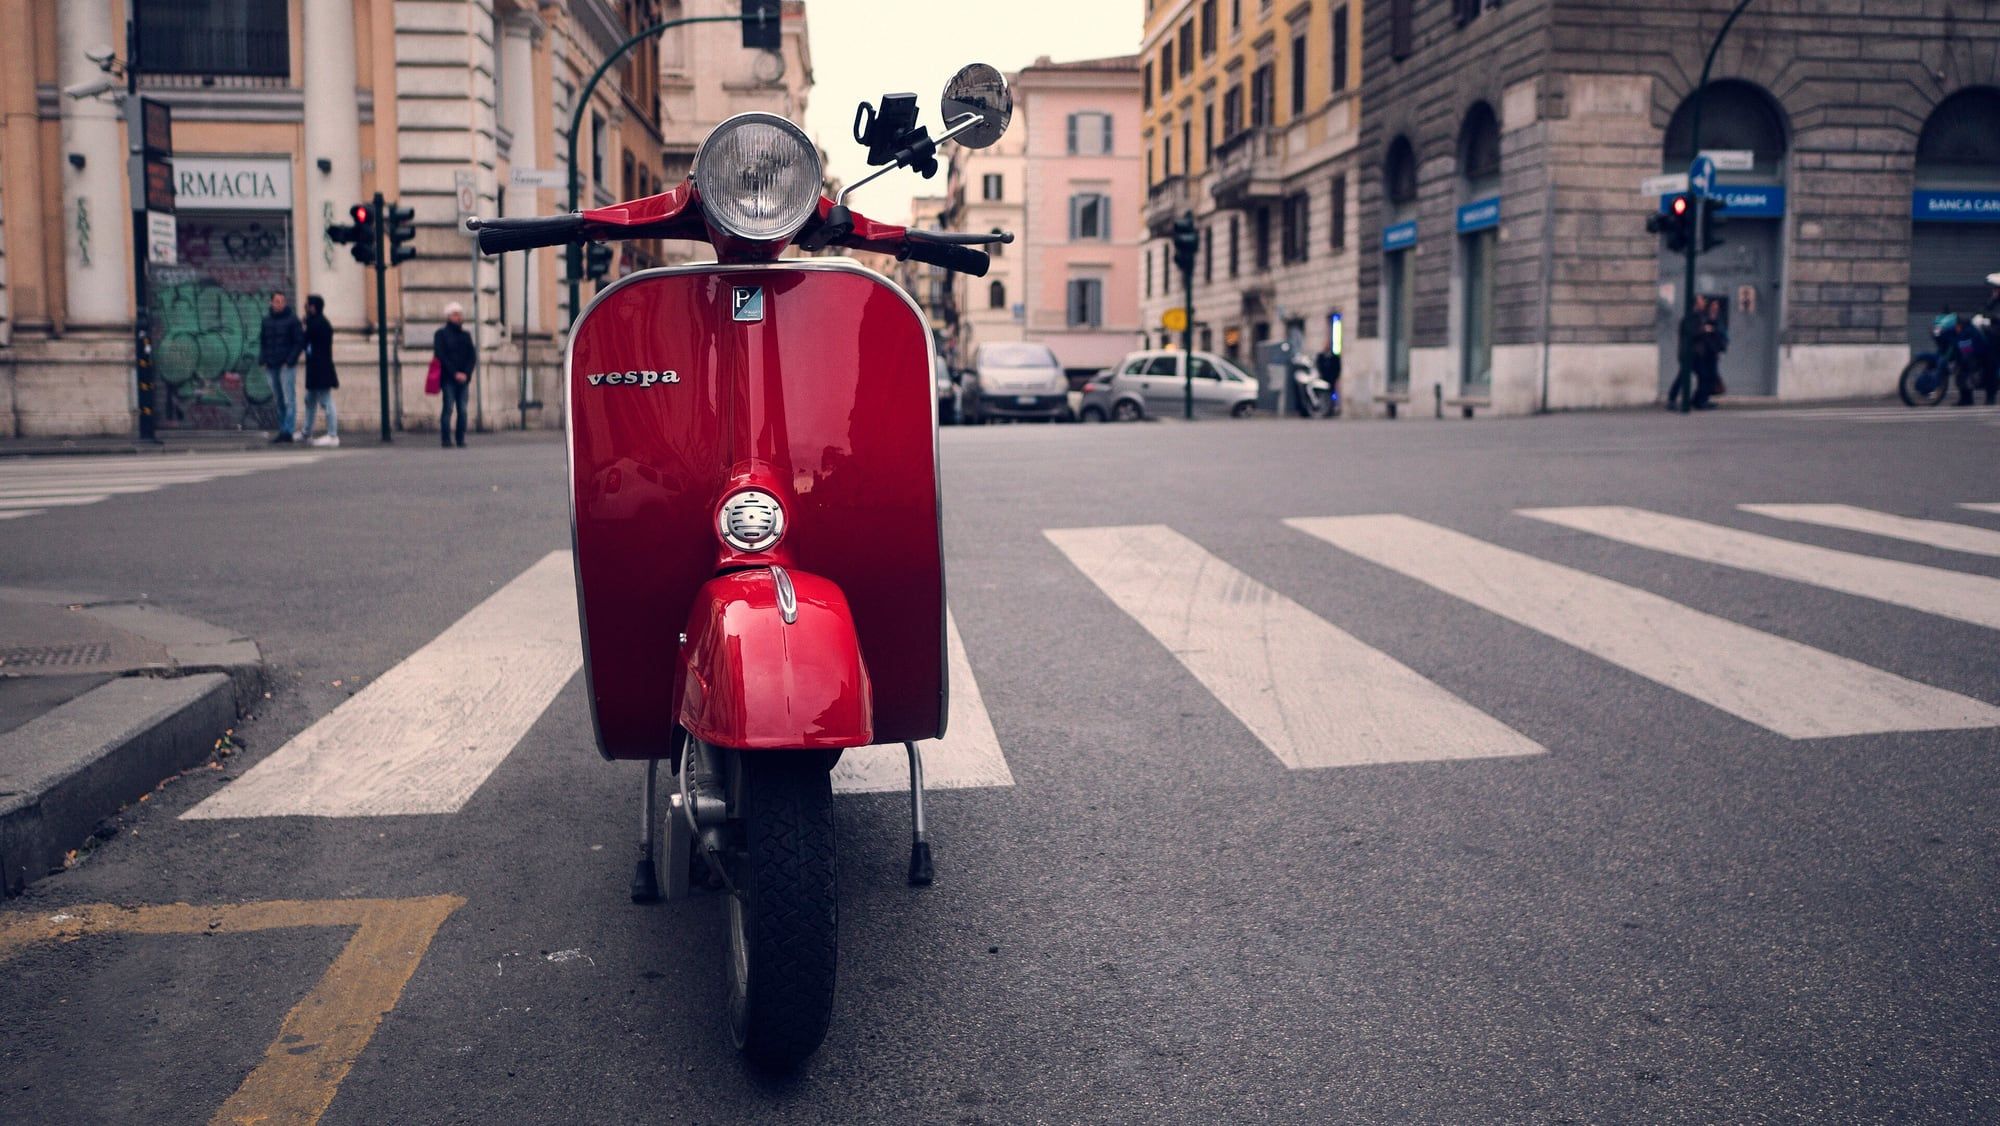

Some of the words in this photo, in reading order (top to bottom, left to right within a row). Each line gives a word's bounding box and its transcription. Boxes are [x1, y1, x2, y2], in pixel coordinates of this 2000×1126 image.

[175, 170, 277, 197] RMACIA
[1928, 198, 1973, 211] BANCA
[736, 289, 750, 308] P
[587, 370, 680, 387] vespa
